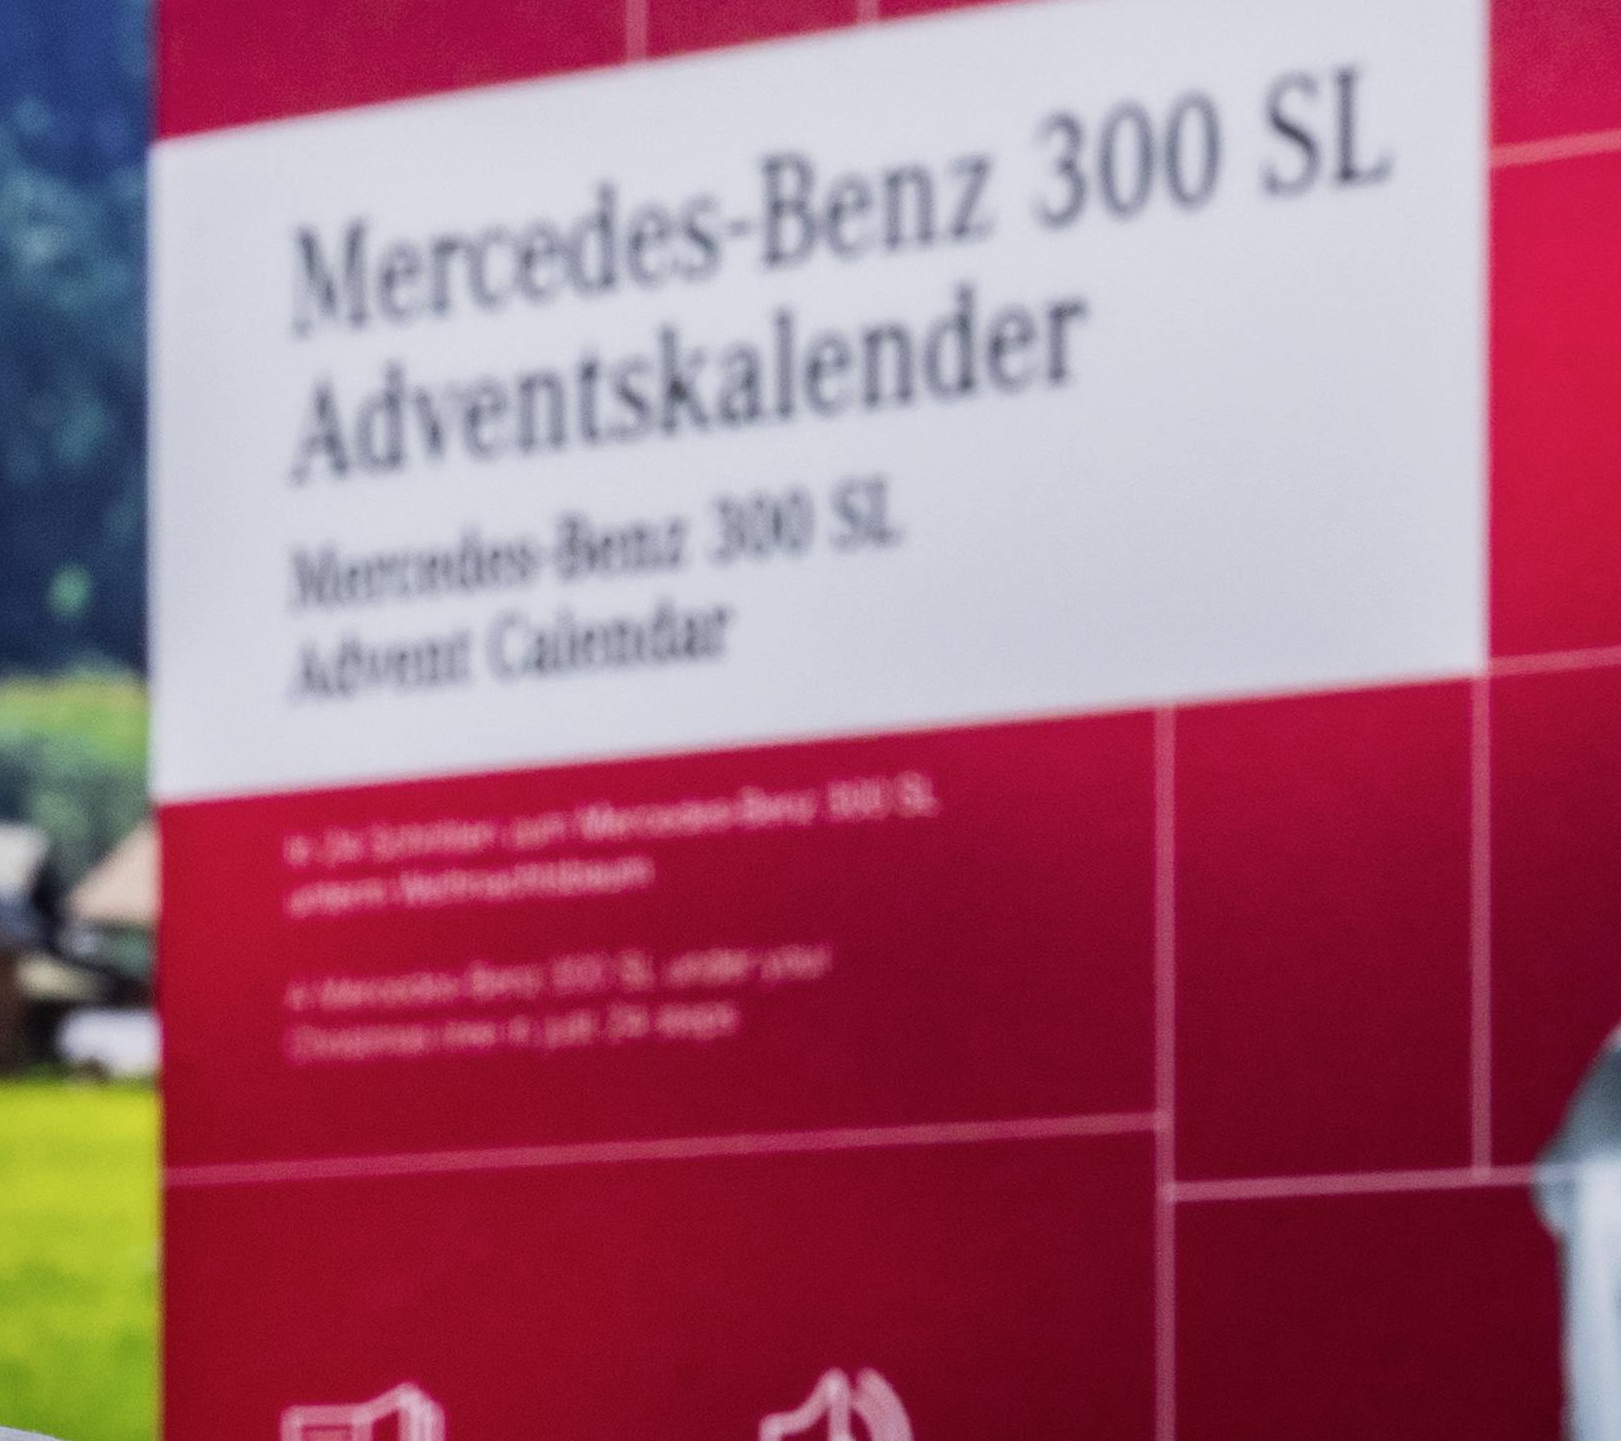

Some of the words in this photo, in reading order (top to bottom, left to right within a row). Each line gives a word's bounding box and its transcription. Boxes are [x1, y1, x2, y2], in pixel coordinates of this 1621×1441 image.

[291, 151, 994, 339] Mercedes-Benz
[1034, 88, 1221, 233] 300
[1261, 63, 1394, 202] SL
[291, 284, 1091, 485] Adventskalender
[289, 512, 685, 614] Mercedes-Benz
[710, 481, 816, 567] 300
[830, 474, 906, 552] SL
[289, 615, 472, 705] Advent
[488, 596, 736, 683] Calendar
